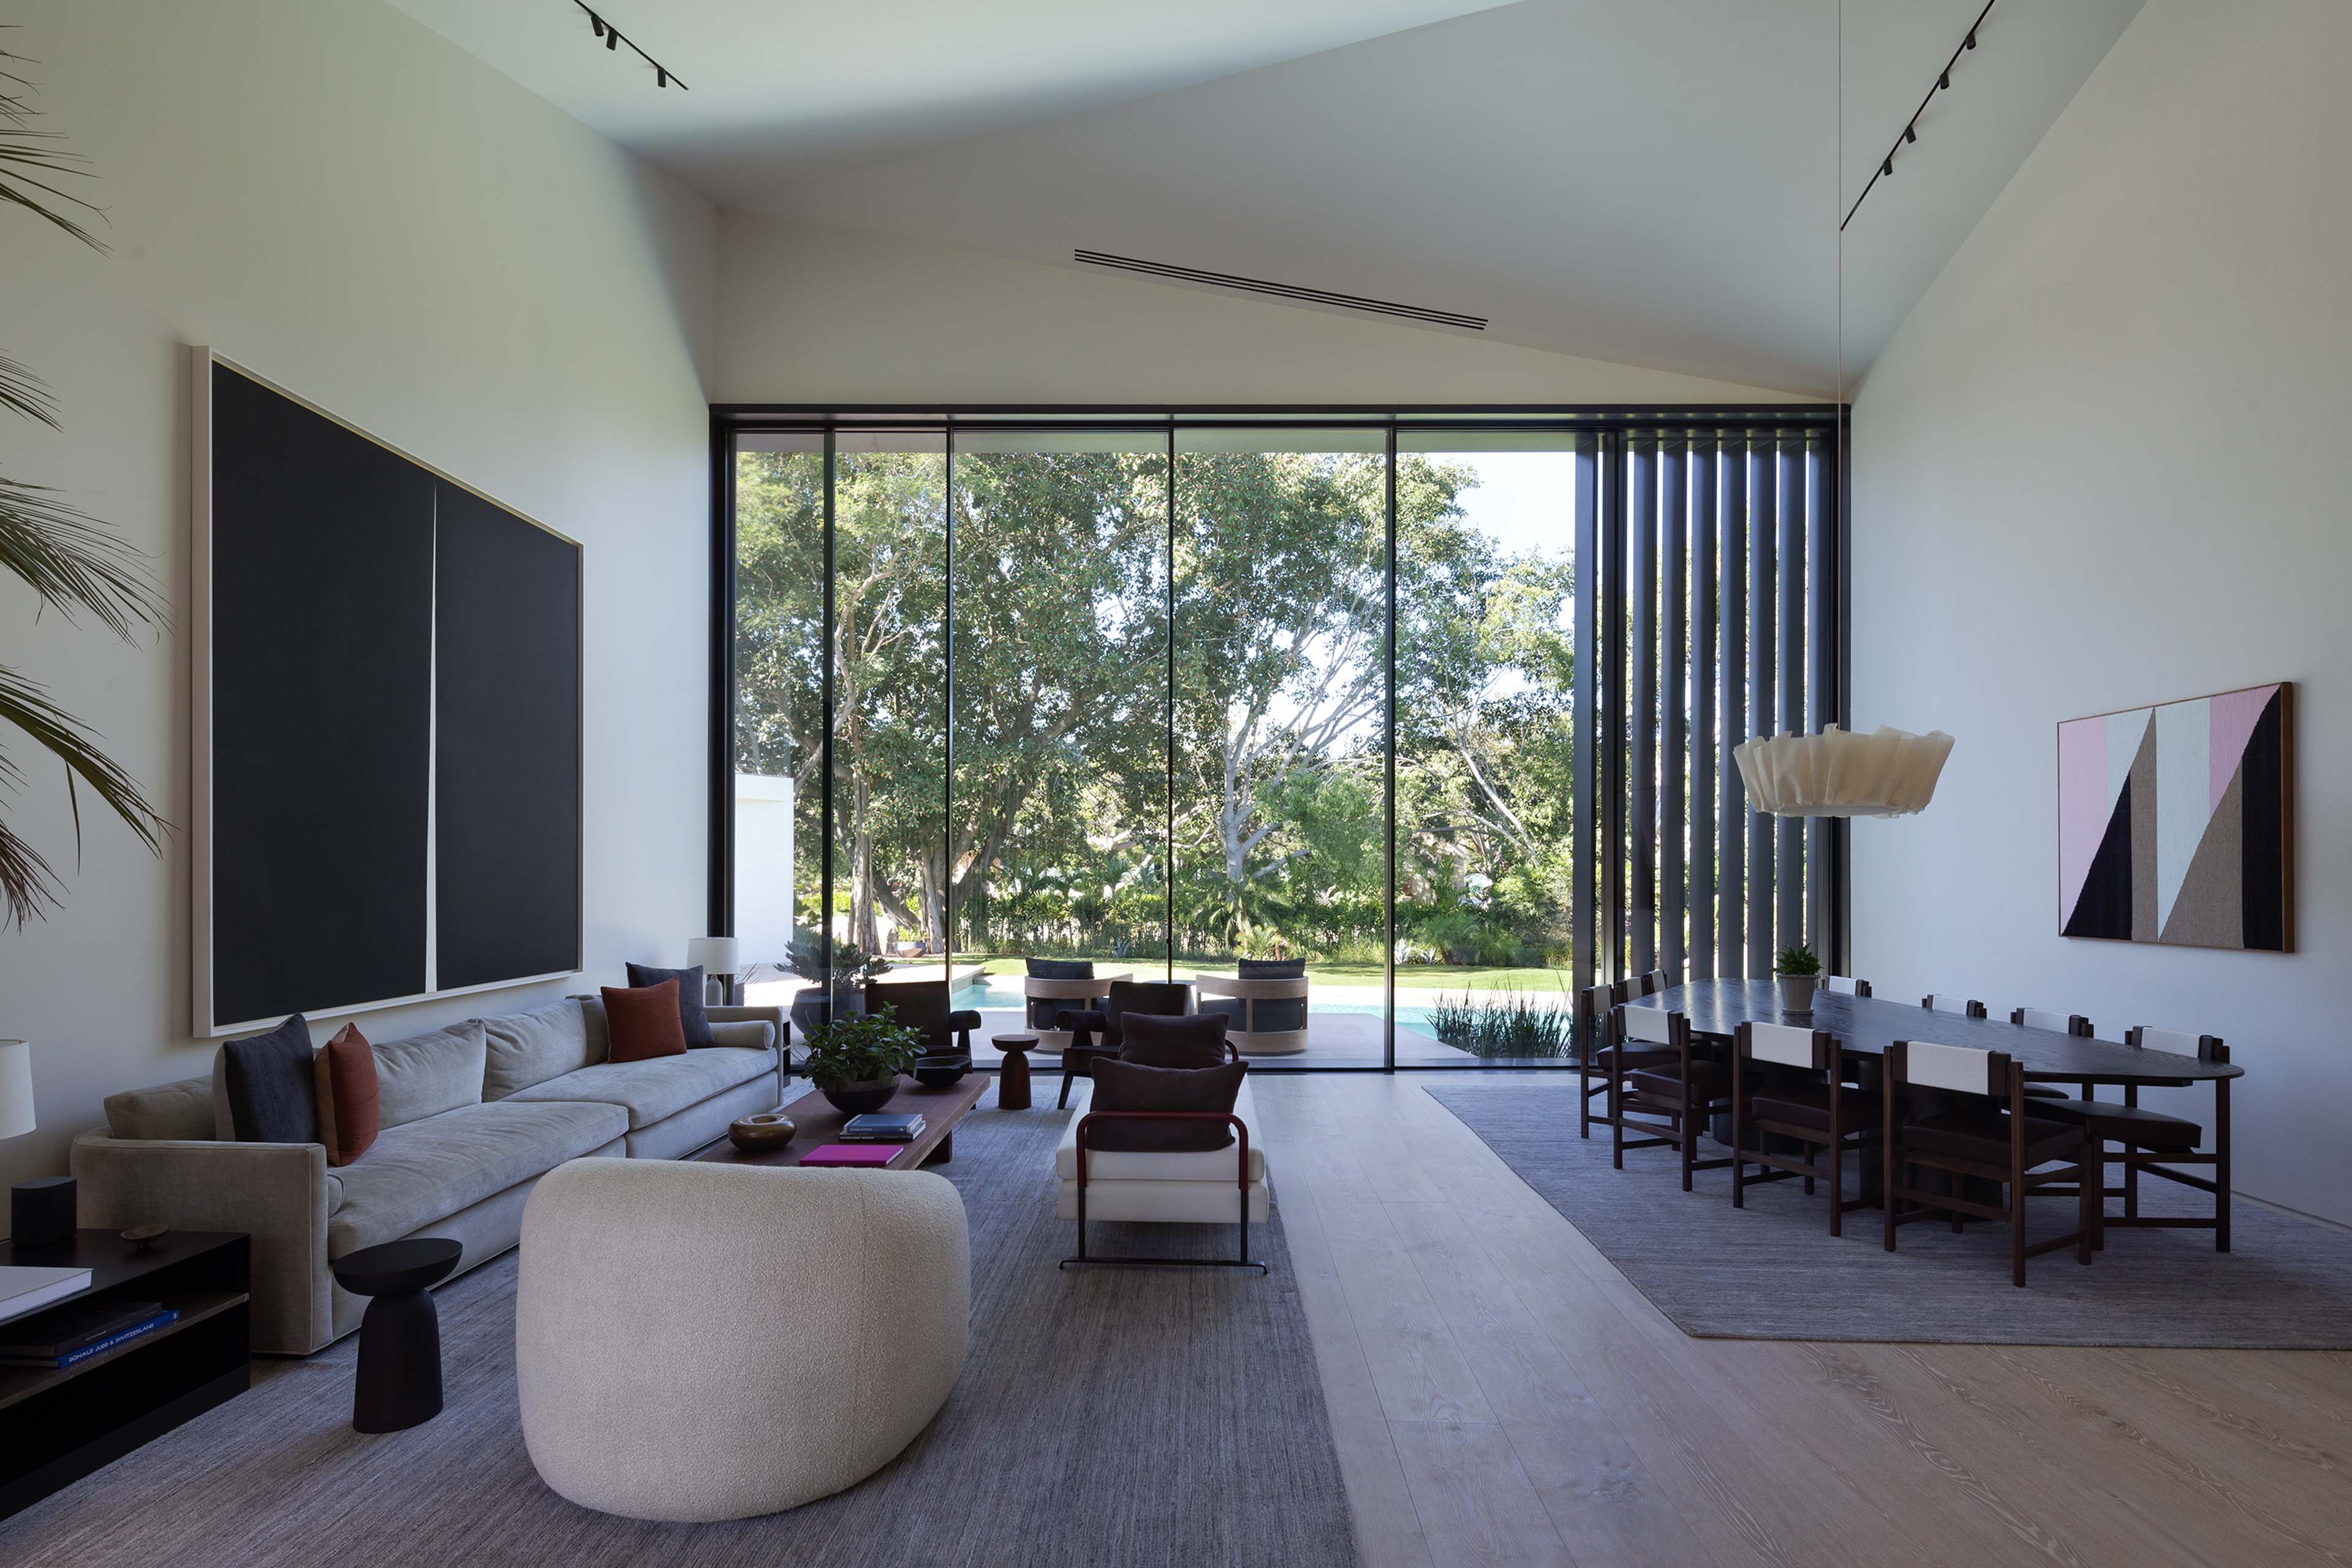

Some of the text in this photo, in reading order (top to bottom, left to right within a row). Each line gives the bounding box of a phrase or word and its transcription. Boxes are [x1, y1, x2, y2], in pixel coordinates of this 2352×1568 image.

[69, 1348, 94, 1363] DONALD
[95, 1342, 110, 1352] JUDD
[115, 1323, 154, 1343] SWITZERLAND
